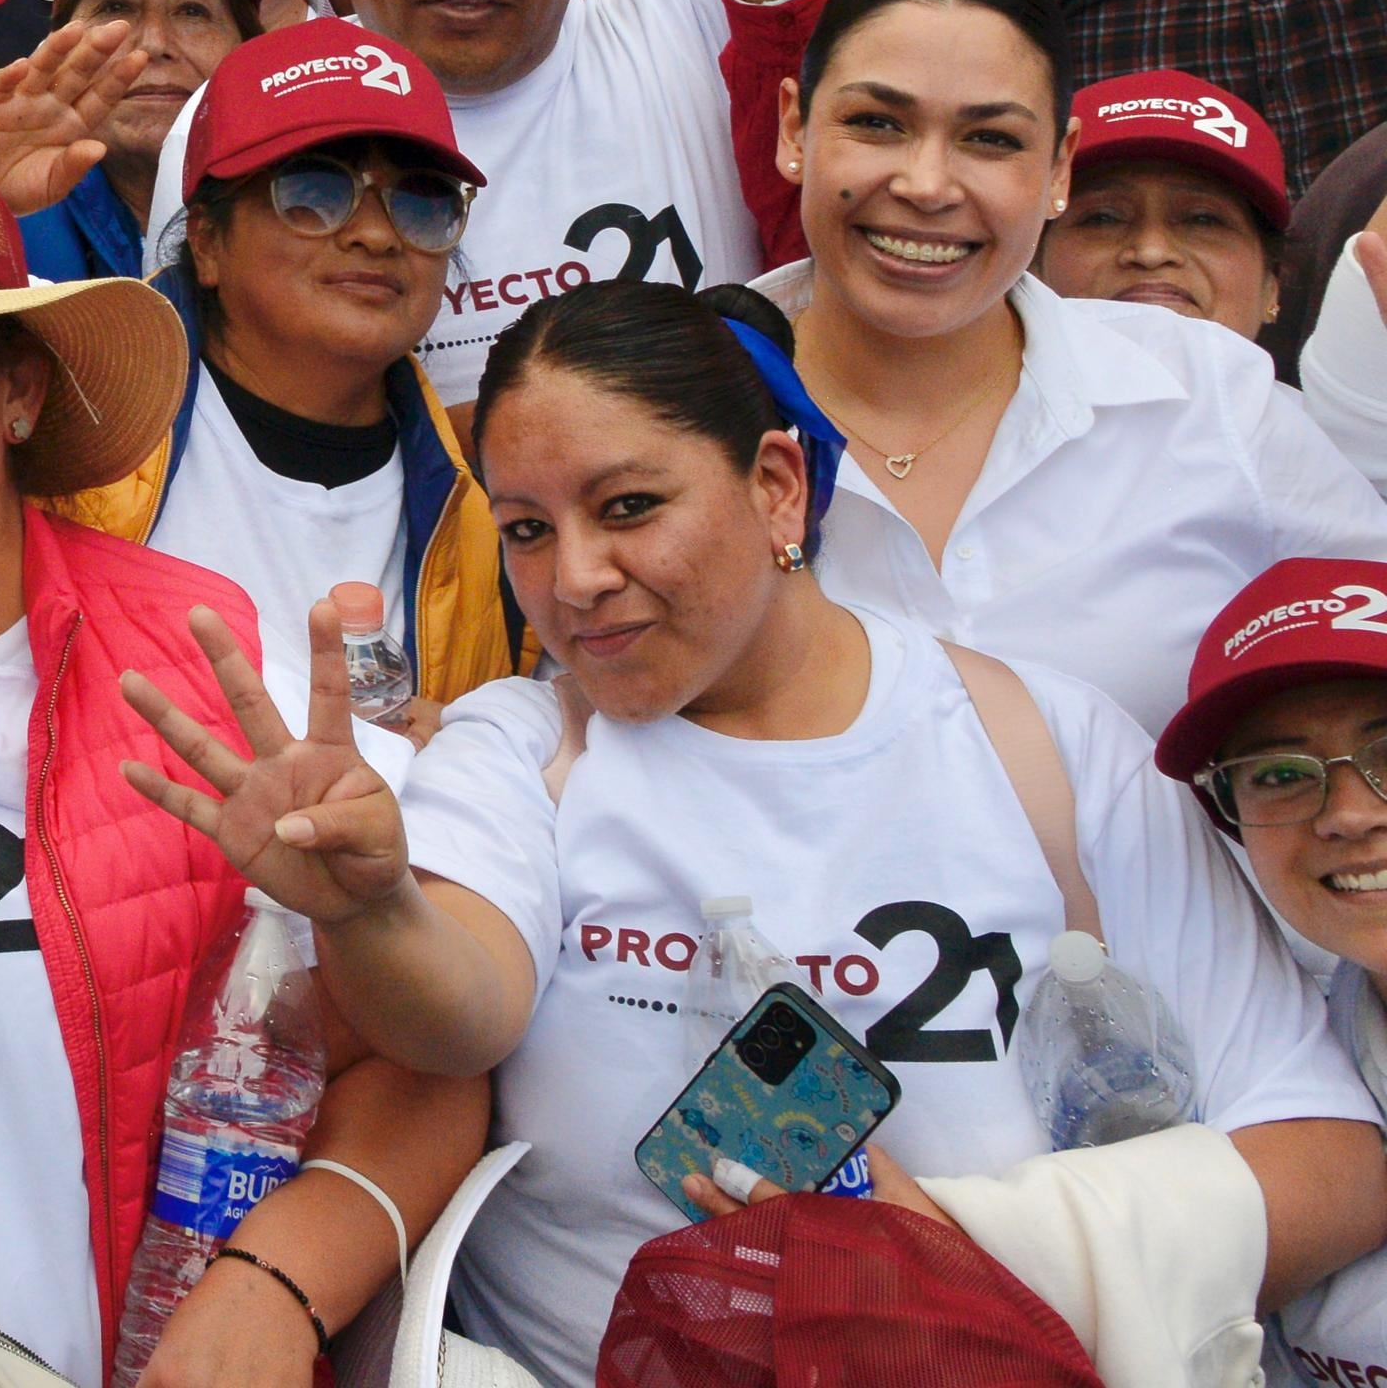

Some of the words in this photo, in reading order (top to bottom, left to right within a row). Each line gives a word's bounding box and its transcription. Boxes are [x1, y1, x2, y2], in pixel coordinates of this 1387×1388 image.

[260, 56, 368, 94] PROYECTO
[354, 44, 412, 97] 21
[1097, 98, 1207, 119] PROYECTO
[1193, 96, 1248, 148] 21
[444, 260, 591, 316] YECTO
[563, 203, 705, 291] 21
[1223, 596, 1348, 659] PROYECTO
[853, 900, 1023, 1063] 21
[228, 1170, 291, 1204] BUR
